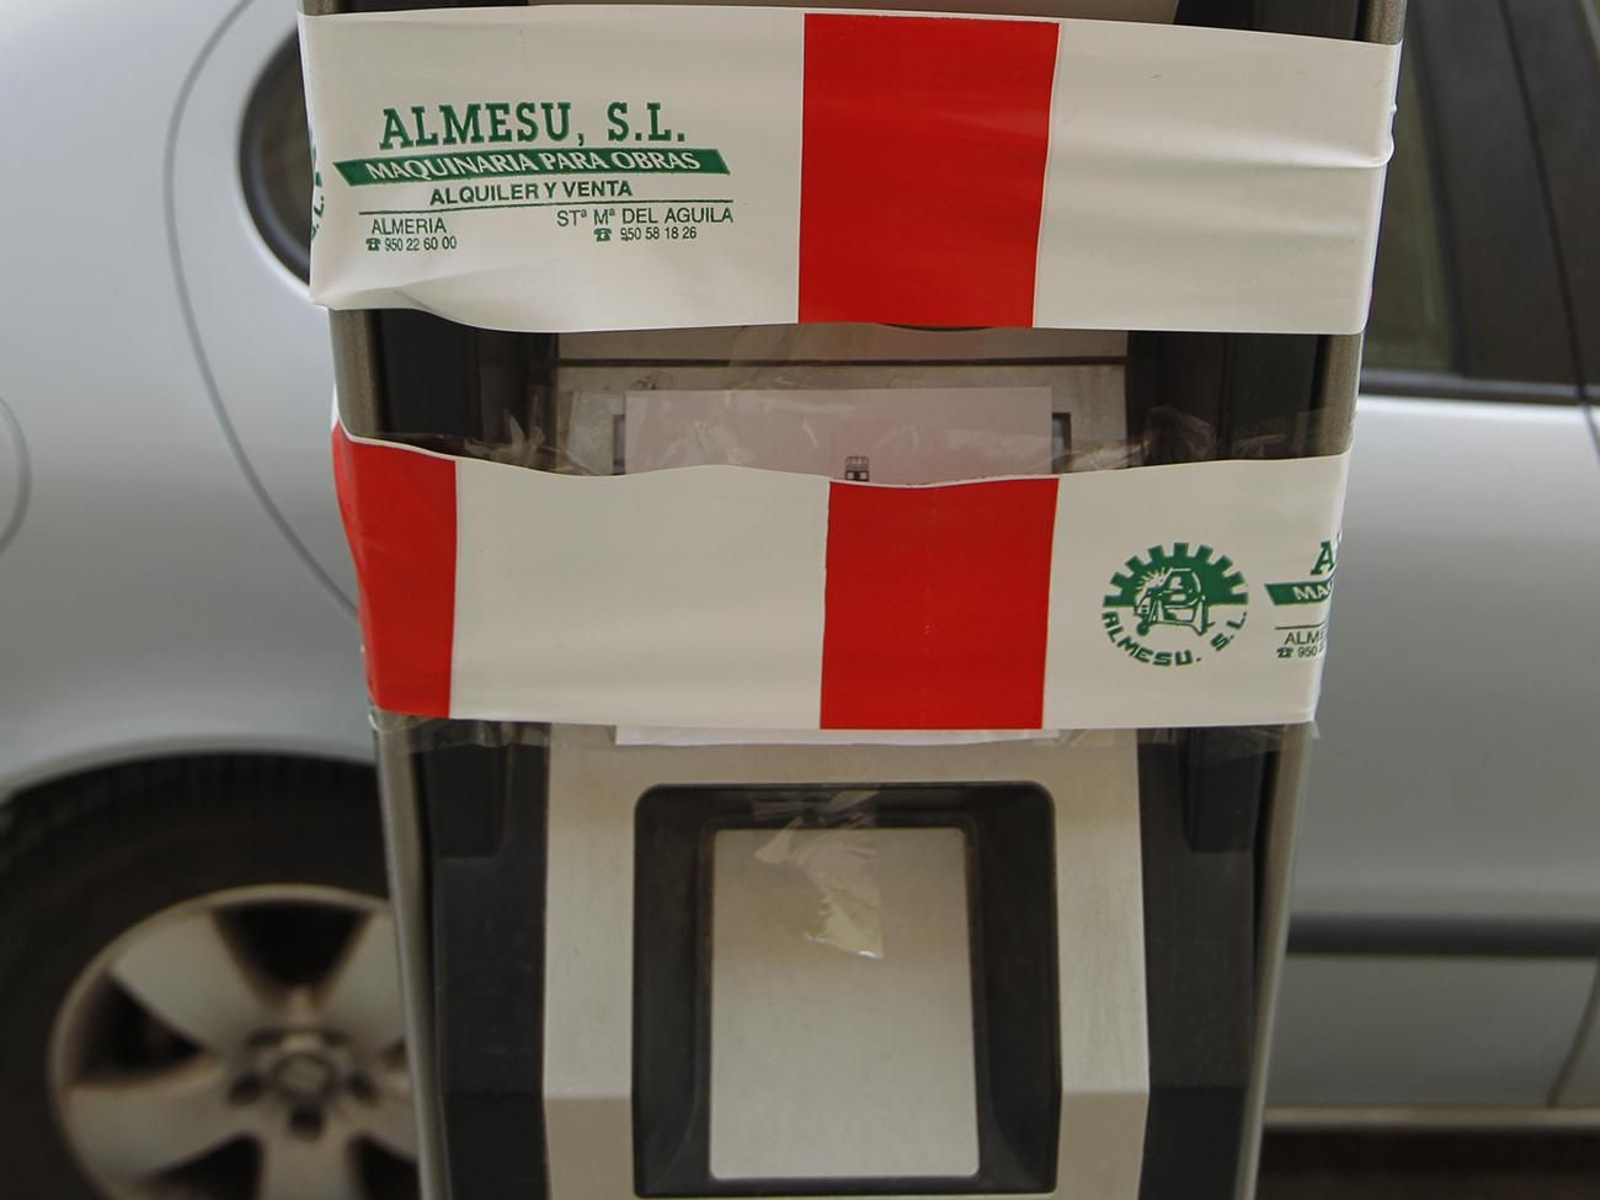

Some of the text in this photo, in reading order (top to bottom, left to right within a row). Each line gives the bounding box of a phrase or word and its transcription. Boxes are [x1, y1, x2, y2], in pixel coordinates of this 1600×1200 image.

[379, 101, 686, 150] ALMESU, S.L.
[364, 150, 702, 181] MAQUINARIA PARA OBRAS
[429, 180, 633, 206] ALQUILER Y VENTA
[622, 208, 659, 224] DEL
[663, 206, 734, 223] AGUILA
[371, 217, 447, 235] ALMERIA
[620, 226, 697, 242] 950 58 18 26
[384, 235, 458, 251] 950 22 60 00
